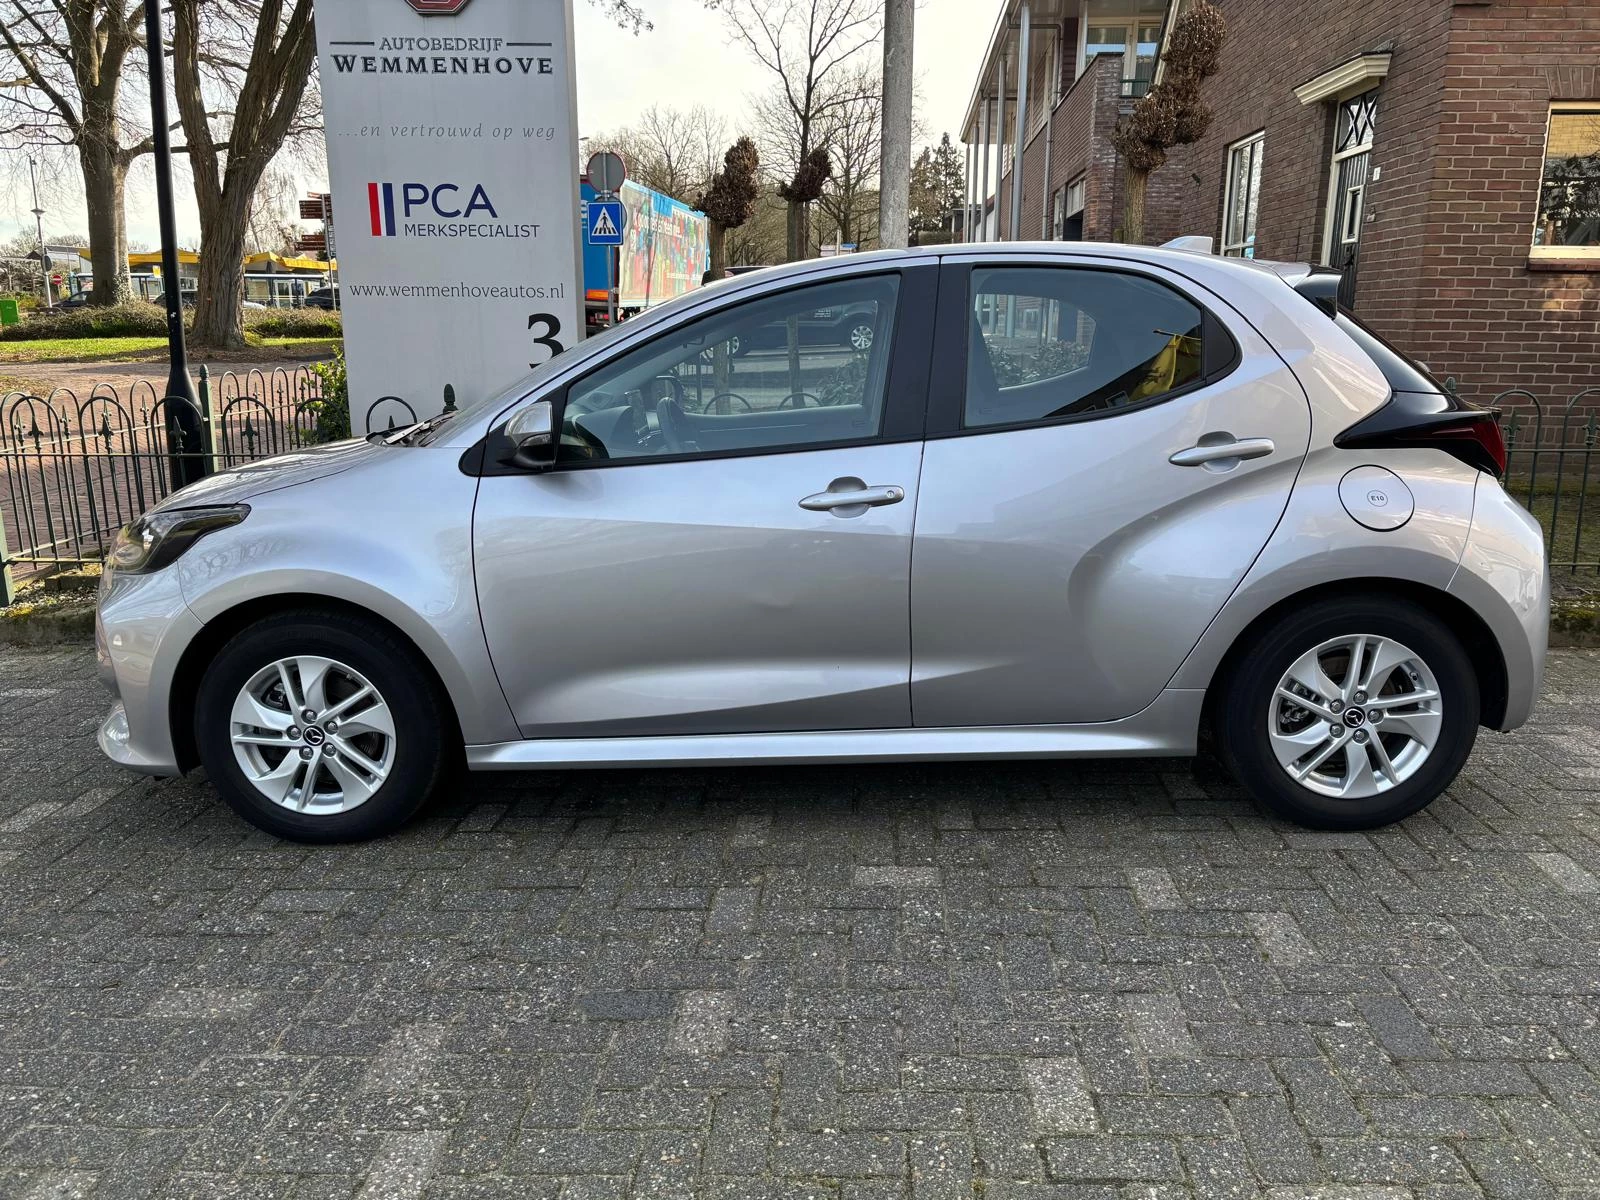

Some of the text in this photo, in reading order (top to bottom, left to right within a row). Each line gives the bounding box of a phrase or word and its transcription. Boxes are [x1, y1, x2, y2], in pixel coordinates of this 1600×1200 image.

[379, 37, 503, 53] AUTOBEDRIJF
[331, 54, 553, 75] WEMMENHOVE
[391, 123, 482, 138] vertrouwd
[492, 126, 513, 140] op
[522, 126, 555, 141] weg
[402, 183, 498, 218] PCA
[404, 223, 541, 238] MERKSPECIALIST
[349, 282, 565, 299] www.wemmenhoveautos.nl
[527, 313, 565, 369] 3
